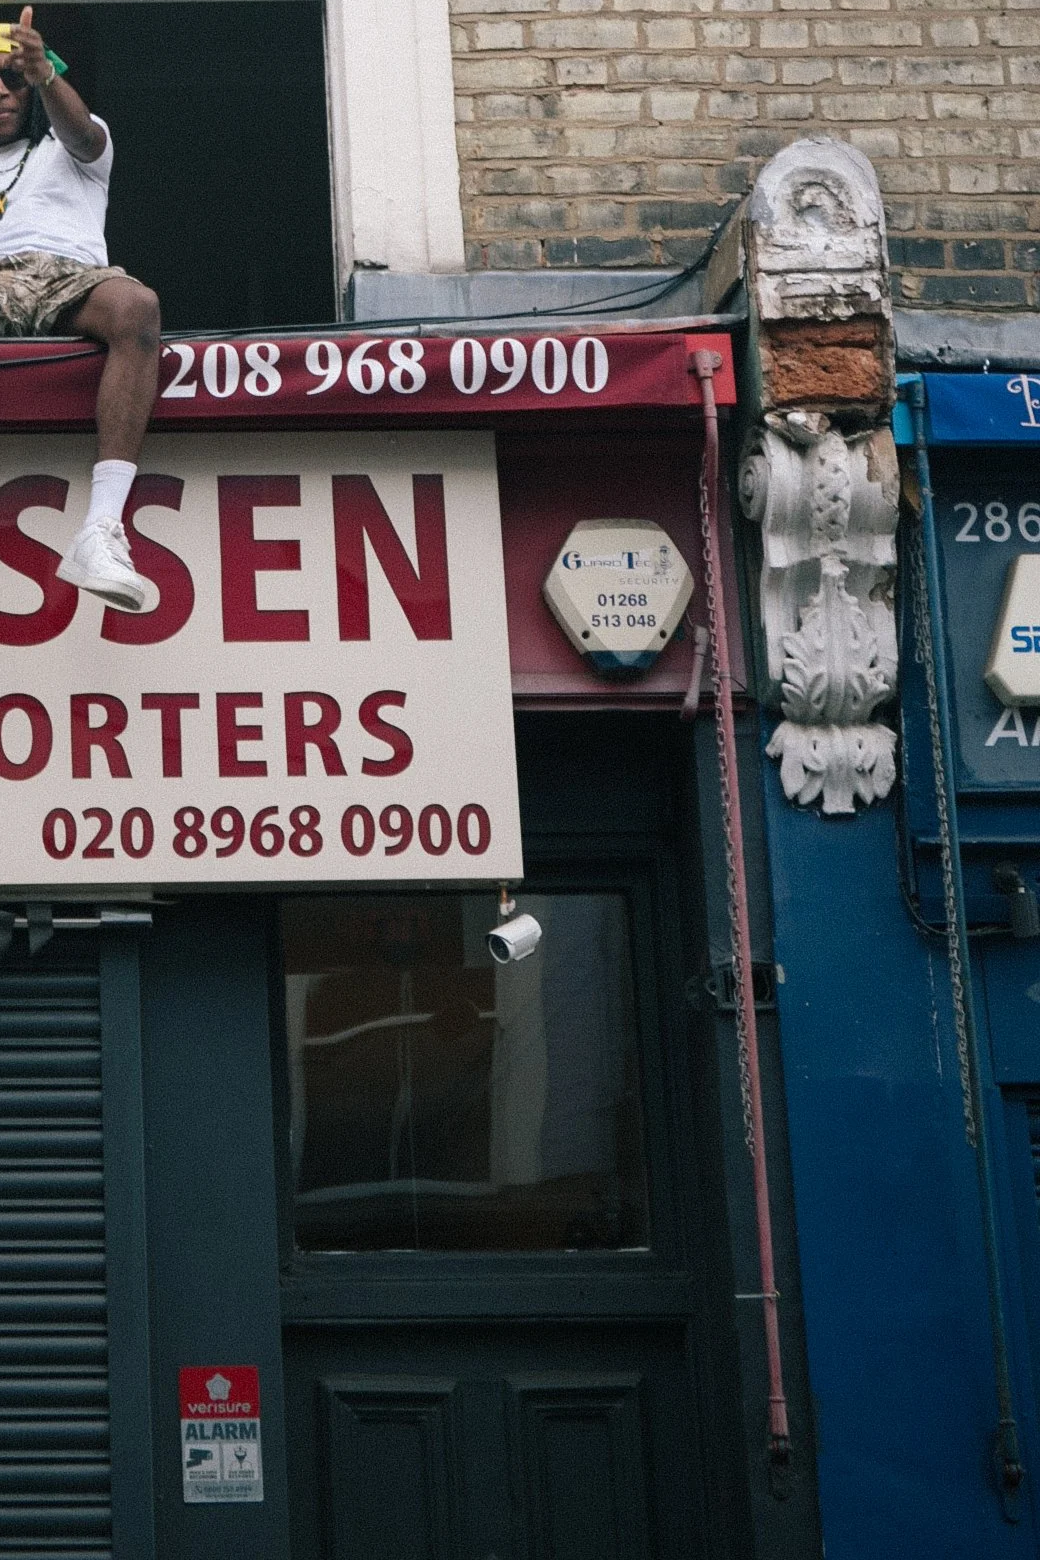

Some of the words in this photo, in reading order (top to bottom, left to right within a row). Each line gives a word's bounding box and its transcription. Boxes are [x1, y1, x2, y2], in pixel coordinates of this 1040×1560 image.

[305, 339, 427, 395] 968
[449, 336, 609, 395] 0900
[597, 593, 648, 607] 01268
[591, 614, 621, 628] 513
[626, 614, 657, 628] 048
[42, 807, 155, 860] 020
[172, 805, 324, 859] 8968
[340, 803, 492, 857] 0900
[188, 1402, 251, 1414] verisure
[185, 1422, 257, 1440] ALARM
